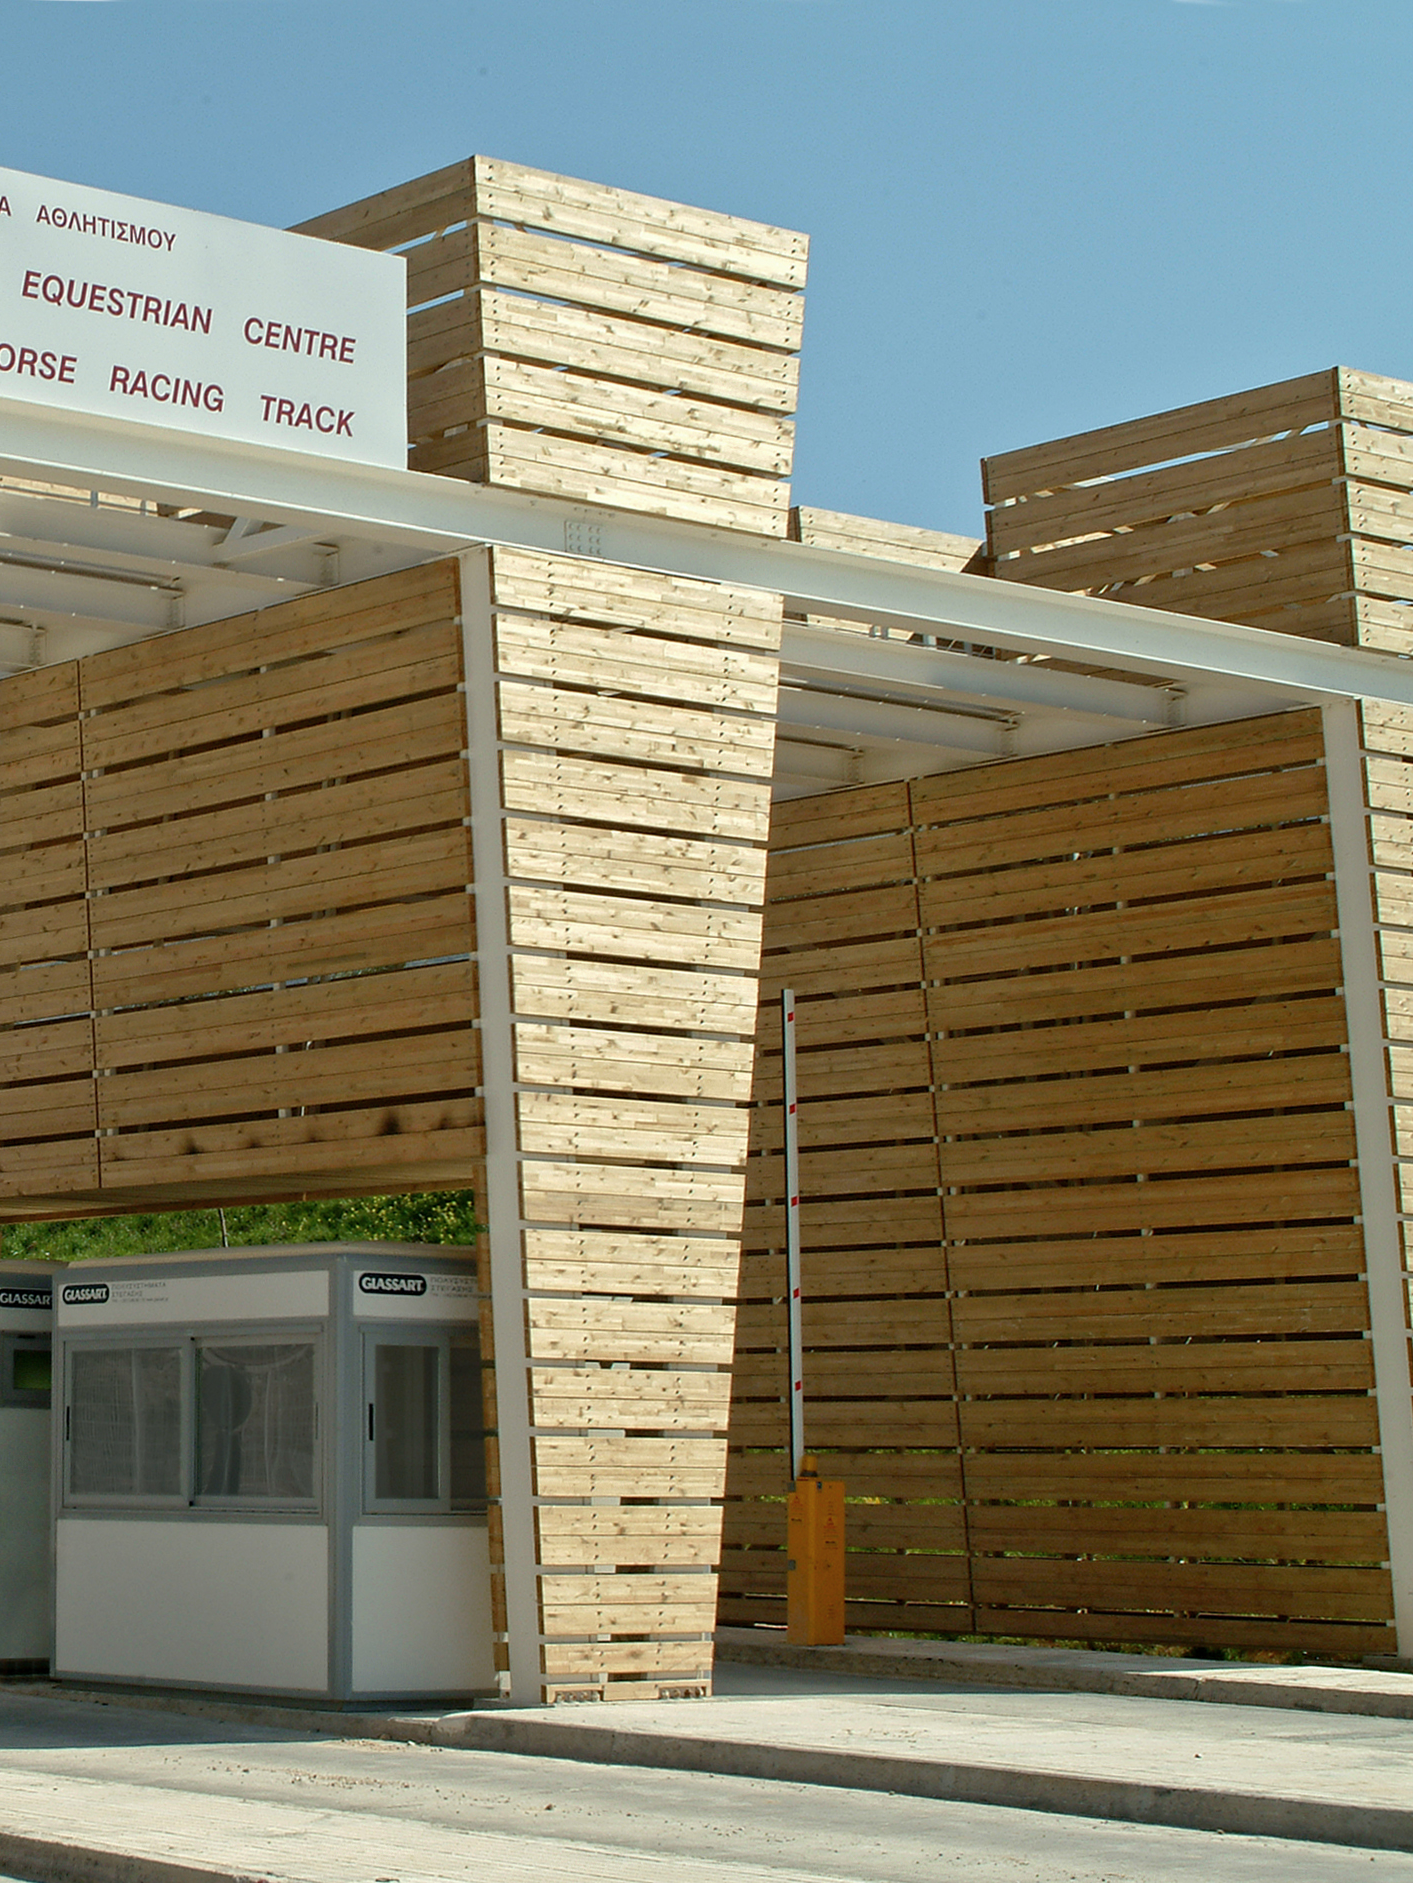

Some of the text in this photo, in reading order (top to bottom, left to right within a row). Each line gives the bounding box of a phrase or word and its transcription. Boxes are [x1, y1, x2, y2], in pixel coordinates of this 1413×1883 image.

[35, 204, 177, 252] ΑΘΛΗΤΙΣΜΟΥ
[20, 269, 214, 336] EQUESTRIAN
[243, 316, 358, 365] CENTRE
[108, 364, 225, 414] RACING
[259, 393, 356, 439] TRACK
[0, 1292, 52, 1305] GLASSAR
[64, 1287, 107, 1302] GLASSART
[361, 1276, 423, 1292] GLASSART
